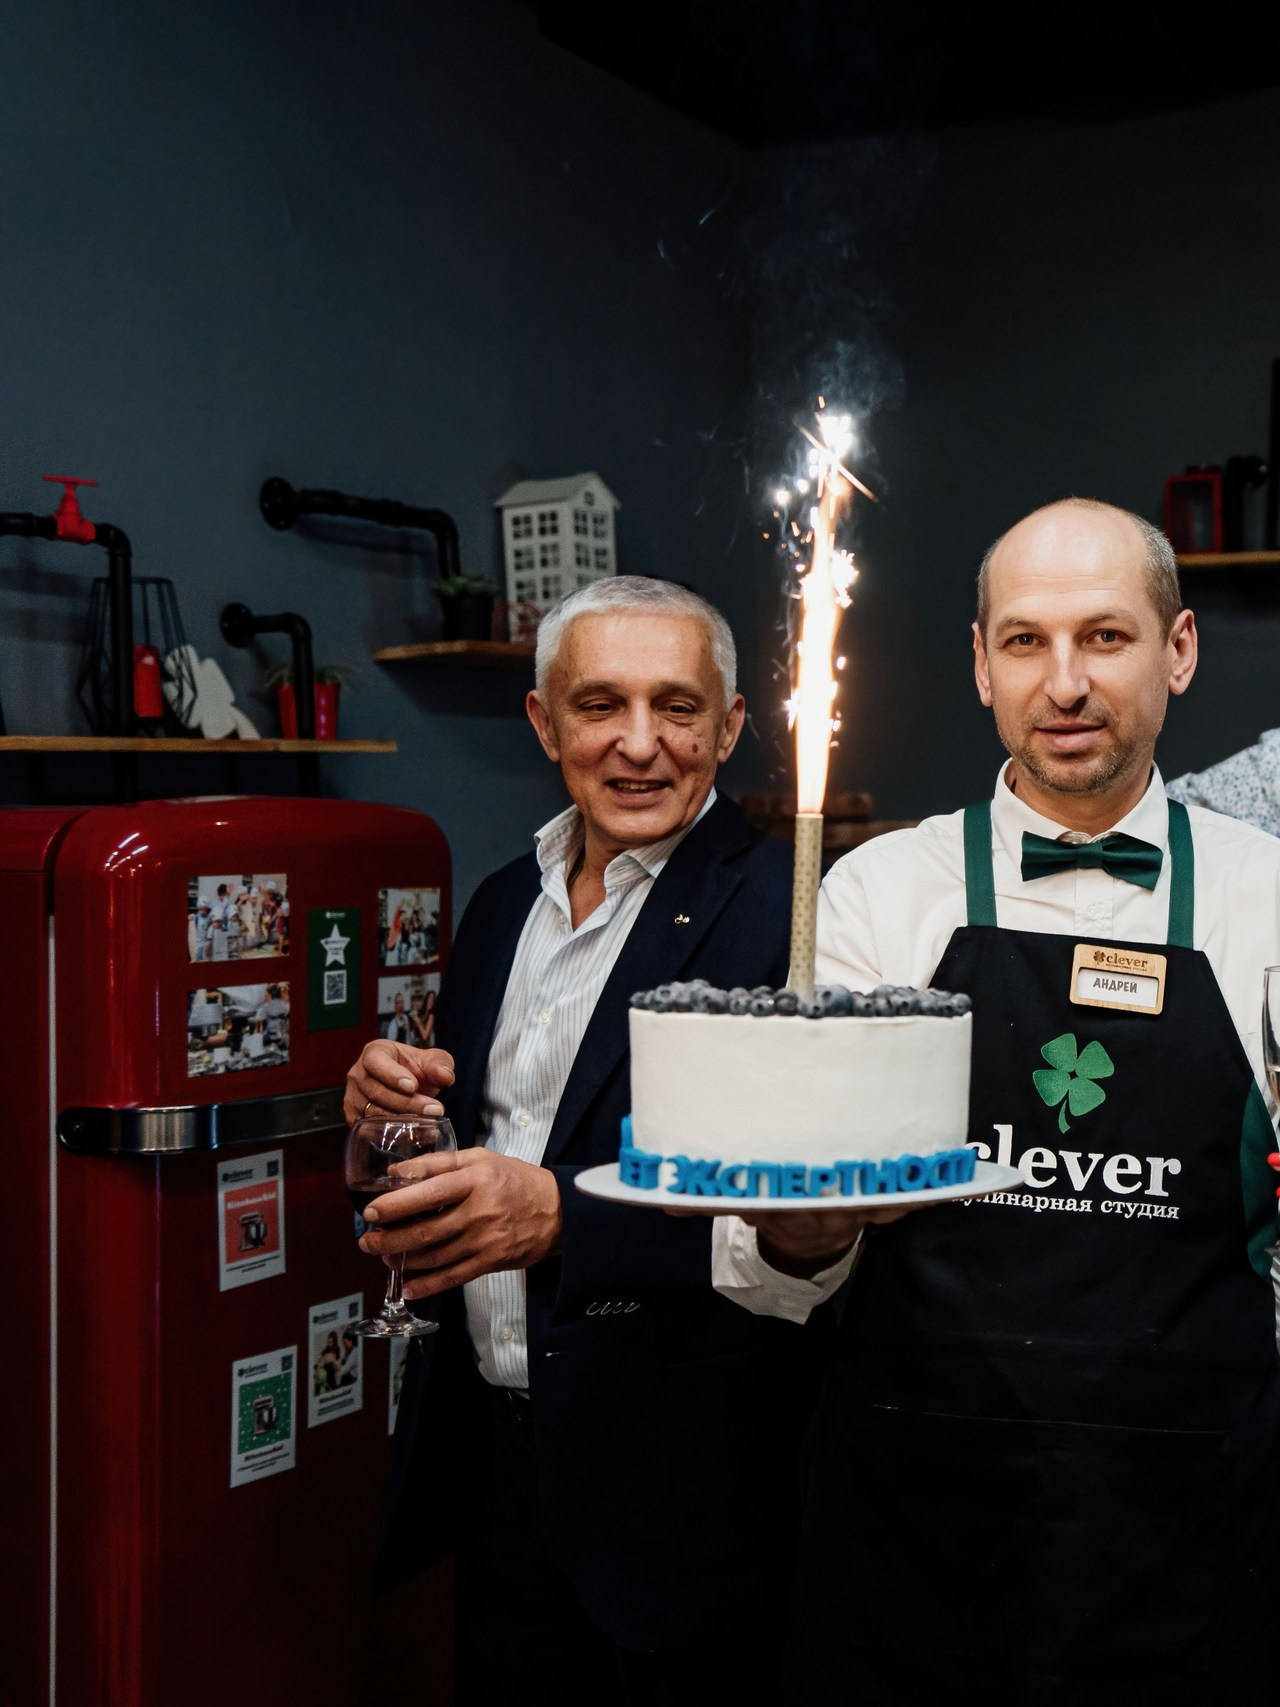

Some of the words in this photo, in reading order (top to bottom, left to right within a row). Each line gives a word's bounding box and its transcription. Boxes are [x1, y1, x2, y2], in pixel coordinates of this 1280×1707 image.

[1106, 953, 1149, 968] clever
[1093, 977, 1138, 993] АНДРЕЙ
[1100, 1199, 1180, 1219] студия
